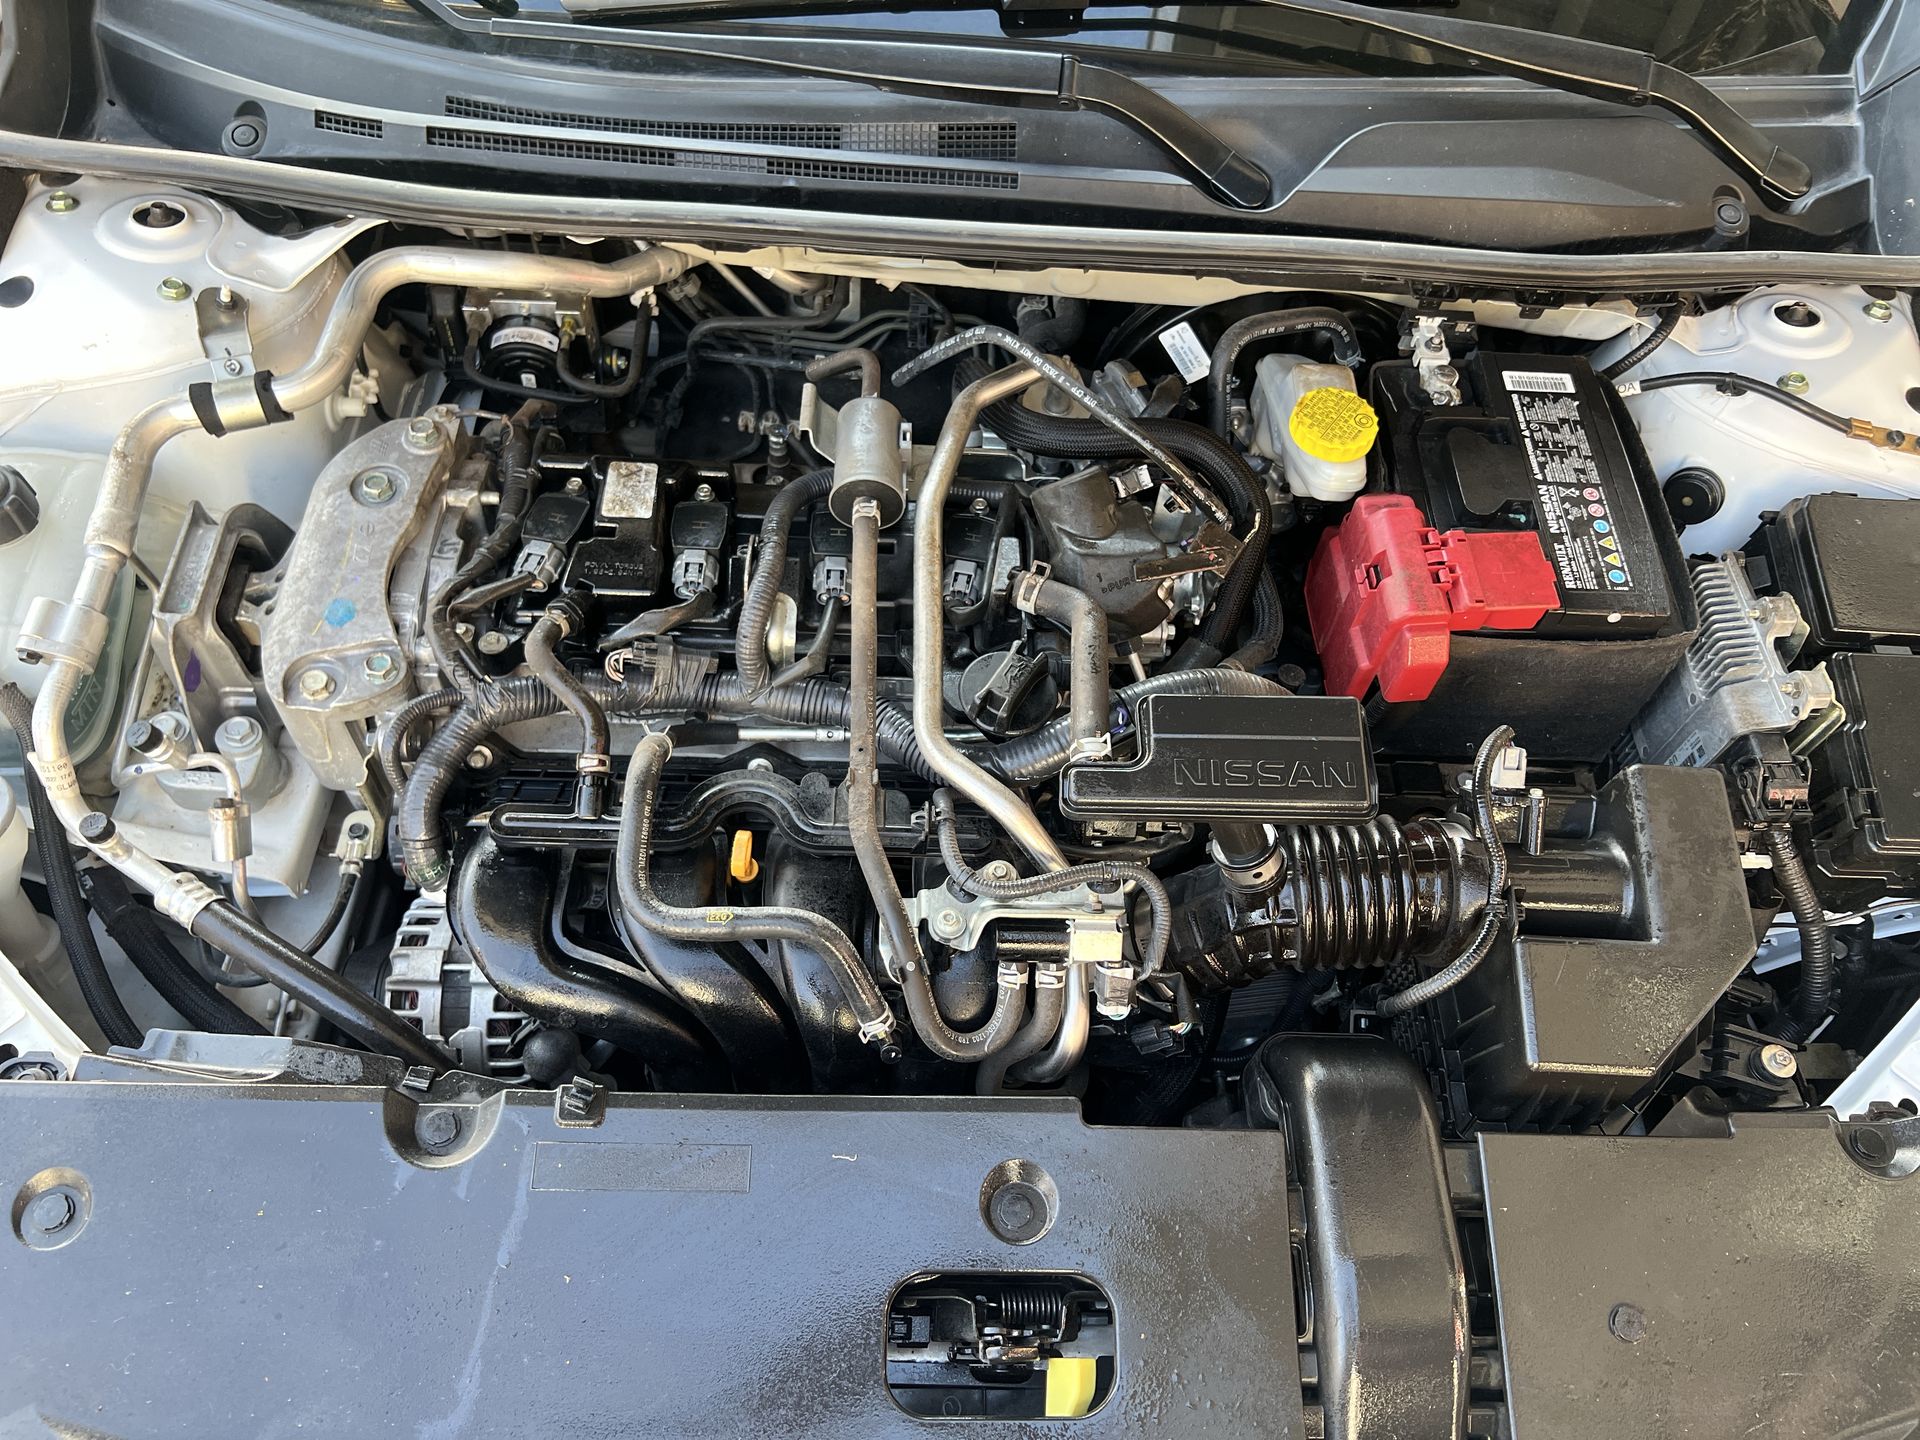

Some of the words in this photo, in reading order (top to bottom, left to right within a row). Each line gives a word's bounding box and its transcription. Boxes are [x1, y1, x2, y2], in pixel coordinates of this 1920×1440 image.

[1019, 346, 1034, 359] NOT
[1032, 355, 1043, 367] DO
[1083, 394, 1098, 408] DTR
[1537, 484, 1560, 533] NISSAN
[1582, 536, 1594, 558] CLARIOS
[1554, 543, 1577, 588] RENAULT
[1174, 758, 1356, 788] NISSAN
[645, 789, 654, 804] DOT
